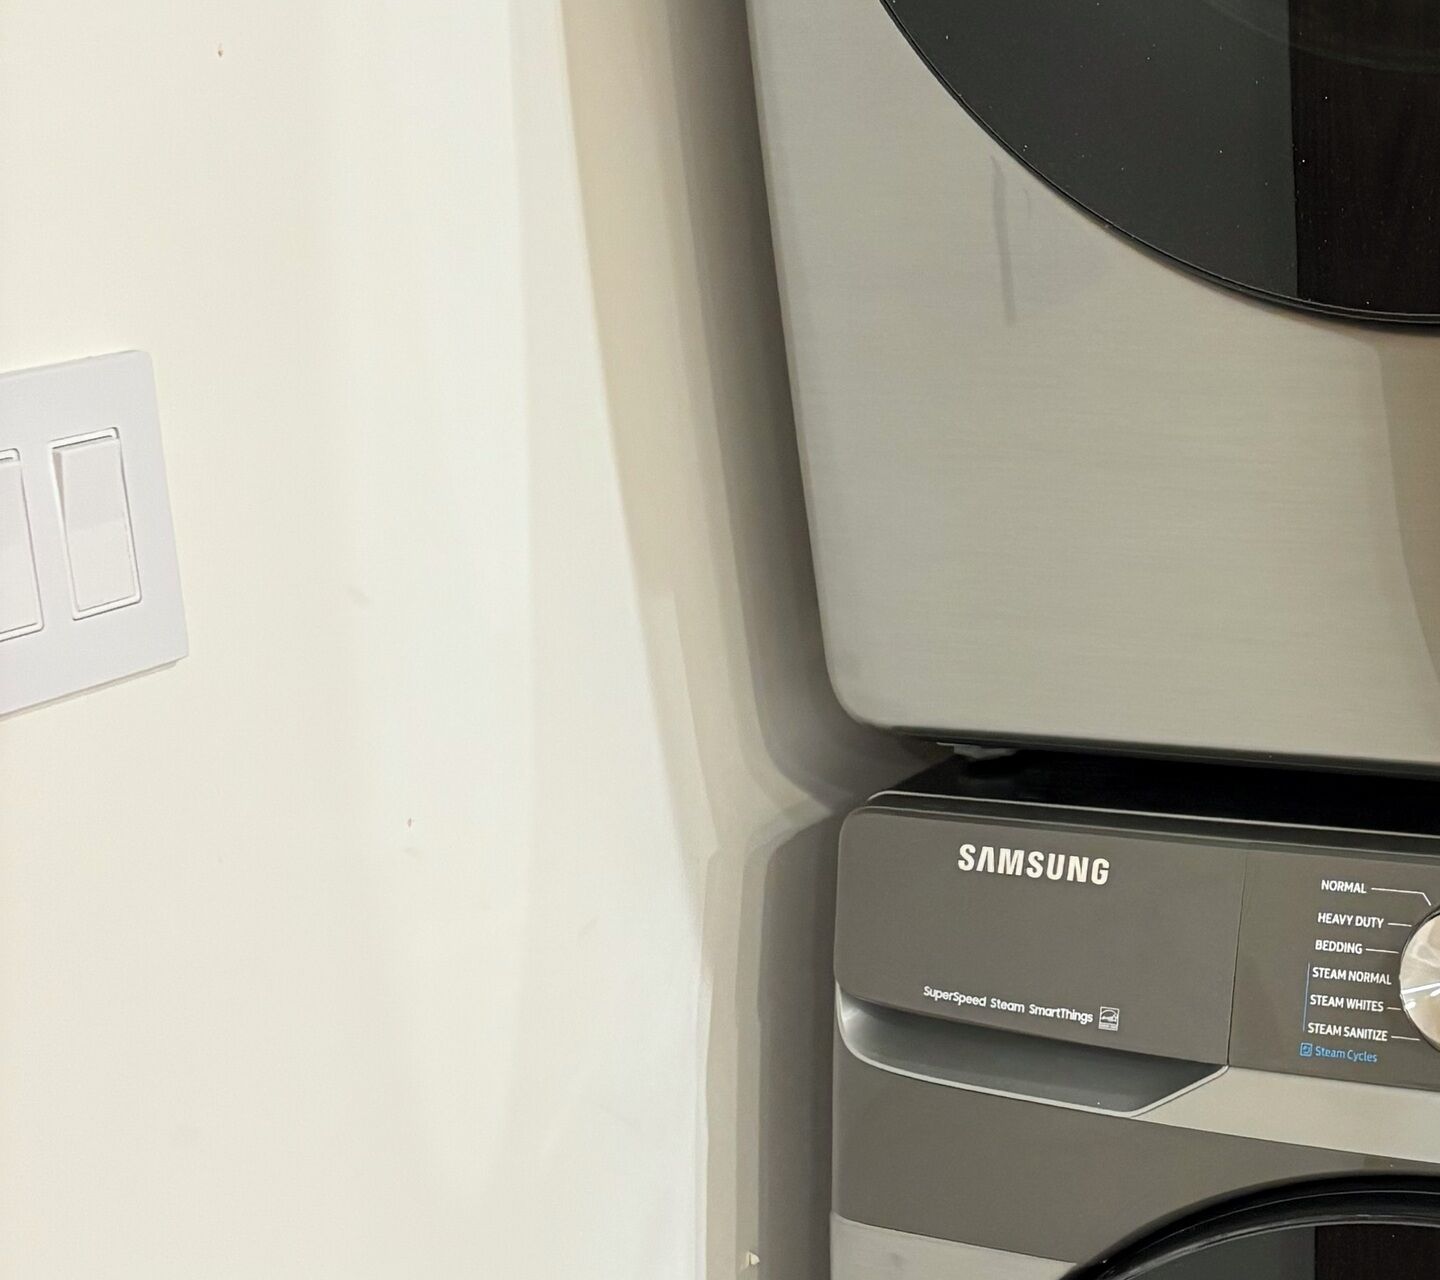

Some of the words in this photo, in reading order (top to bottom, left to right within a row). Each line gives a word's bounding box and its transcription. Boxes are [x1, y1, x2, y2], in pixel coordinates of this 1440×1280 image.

[957, 843, 1110, 885] SAMSUNG
[1321, 879, 1367, 894] NORMAL
[1317, 912, 1353, 926] HEAVY
[1355, 915, 1384, 929] DUTY
[1315, 939, 1363, 955] BEDDING
[1312, 966, 1347, 981] STEAM
[1347, 970, 1392, 986] NORMAL
[923, 985, 987, 1007] SuperSpeed
[990, 998, 1025, 1014] Steam
[1029, 1004, 1094, 1025] SmartThings
[1310, 994, 1345, 1009] STEAM
[1346, 998, 1384, 1013] WHITES
[1307, 1022, 1342, 1037] STEAM
[1343, 1026, 1389, 1042] SANITIZE
[1315, 1046, 1346, 1059] Steam
[1346, 1049, 1378, 1063] Cycles
